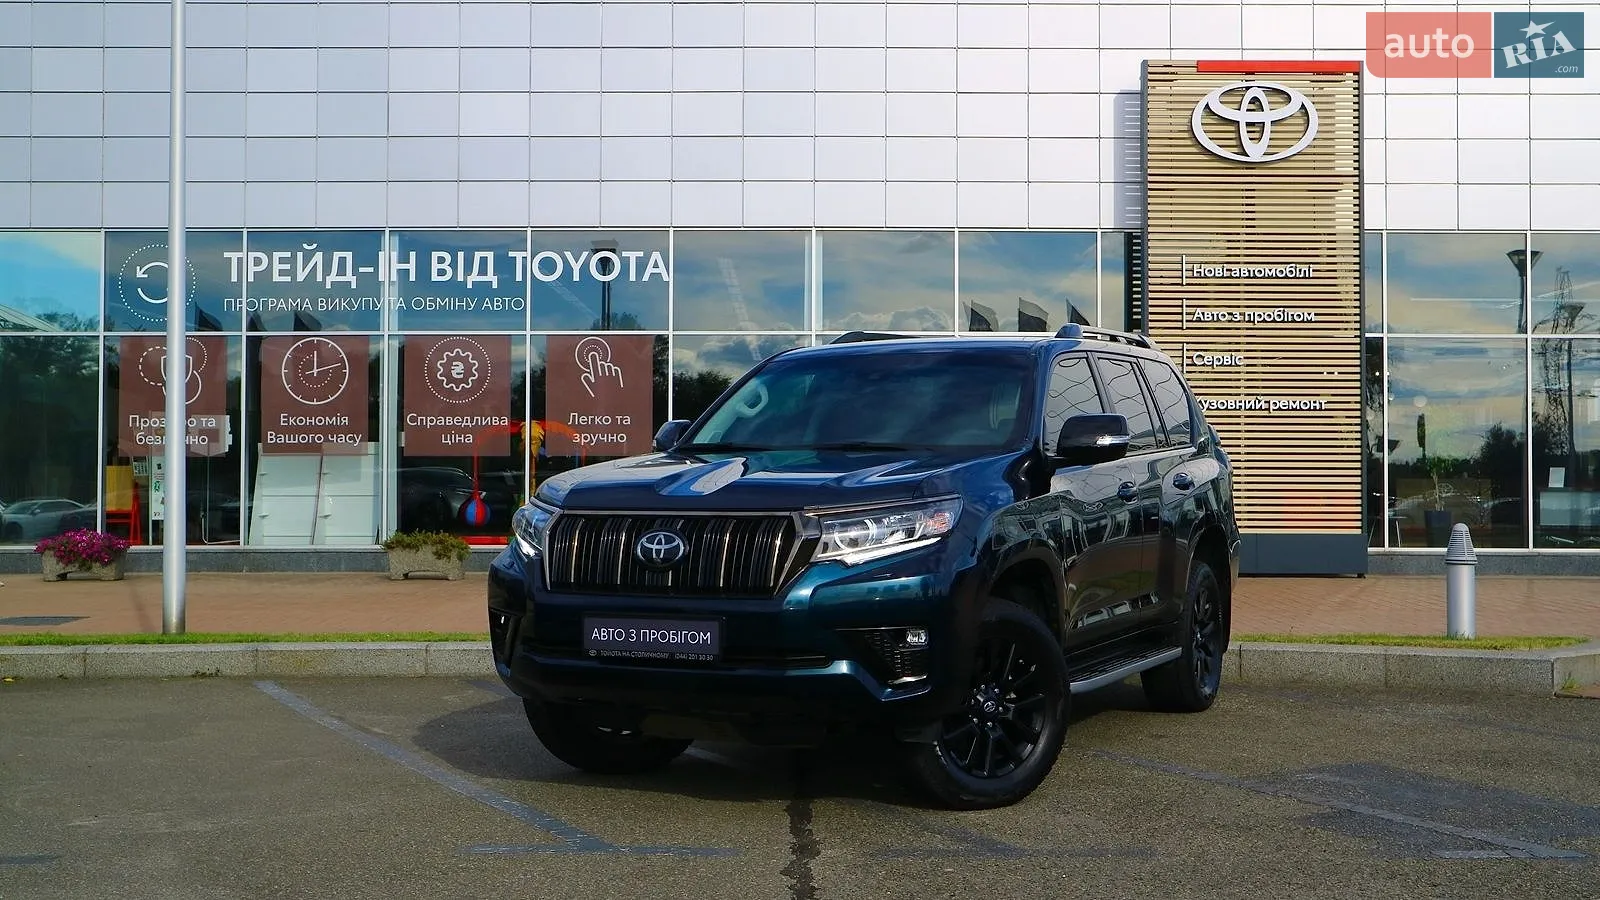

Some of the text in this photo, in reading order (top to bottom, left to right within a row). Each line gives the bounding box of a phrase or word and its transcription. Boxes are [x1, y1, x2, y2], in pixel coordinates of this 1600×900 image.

[223, 243, 670, 289] ТРЕЙД-ІН ВІД TOYOTA
[1192, 264, 1314, 278] Нові автомобілі
[223, 297, 525, 312] ПРОГРАМА ВИКУПУ ТА ОБМІНУ АВТО
[1192, 308, 1315, 325] Авто з пробігом
[1192, 352, 1245, 368] Сервіс
[1269, 400, 1328, 413] ремонт
[128, 414, 217, 430] Прозо та
[280, 413, 349, 427] Економія
[406, 413, 509, 428] Справедлива
[568, 412, 631, 426] Легко та
[135, 431, 209, 445] безно
[267, 432, 362, 446] Вашого часу
[441, 431, 473, 445] ціна
[572, 433, 627, 446] зручно
[591, 627, 711, 645] АВТО З ПРОБІГОМ
